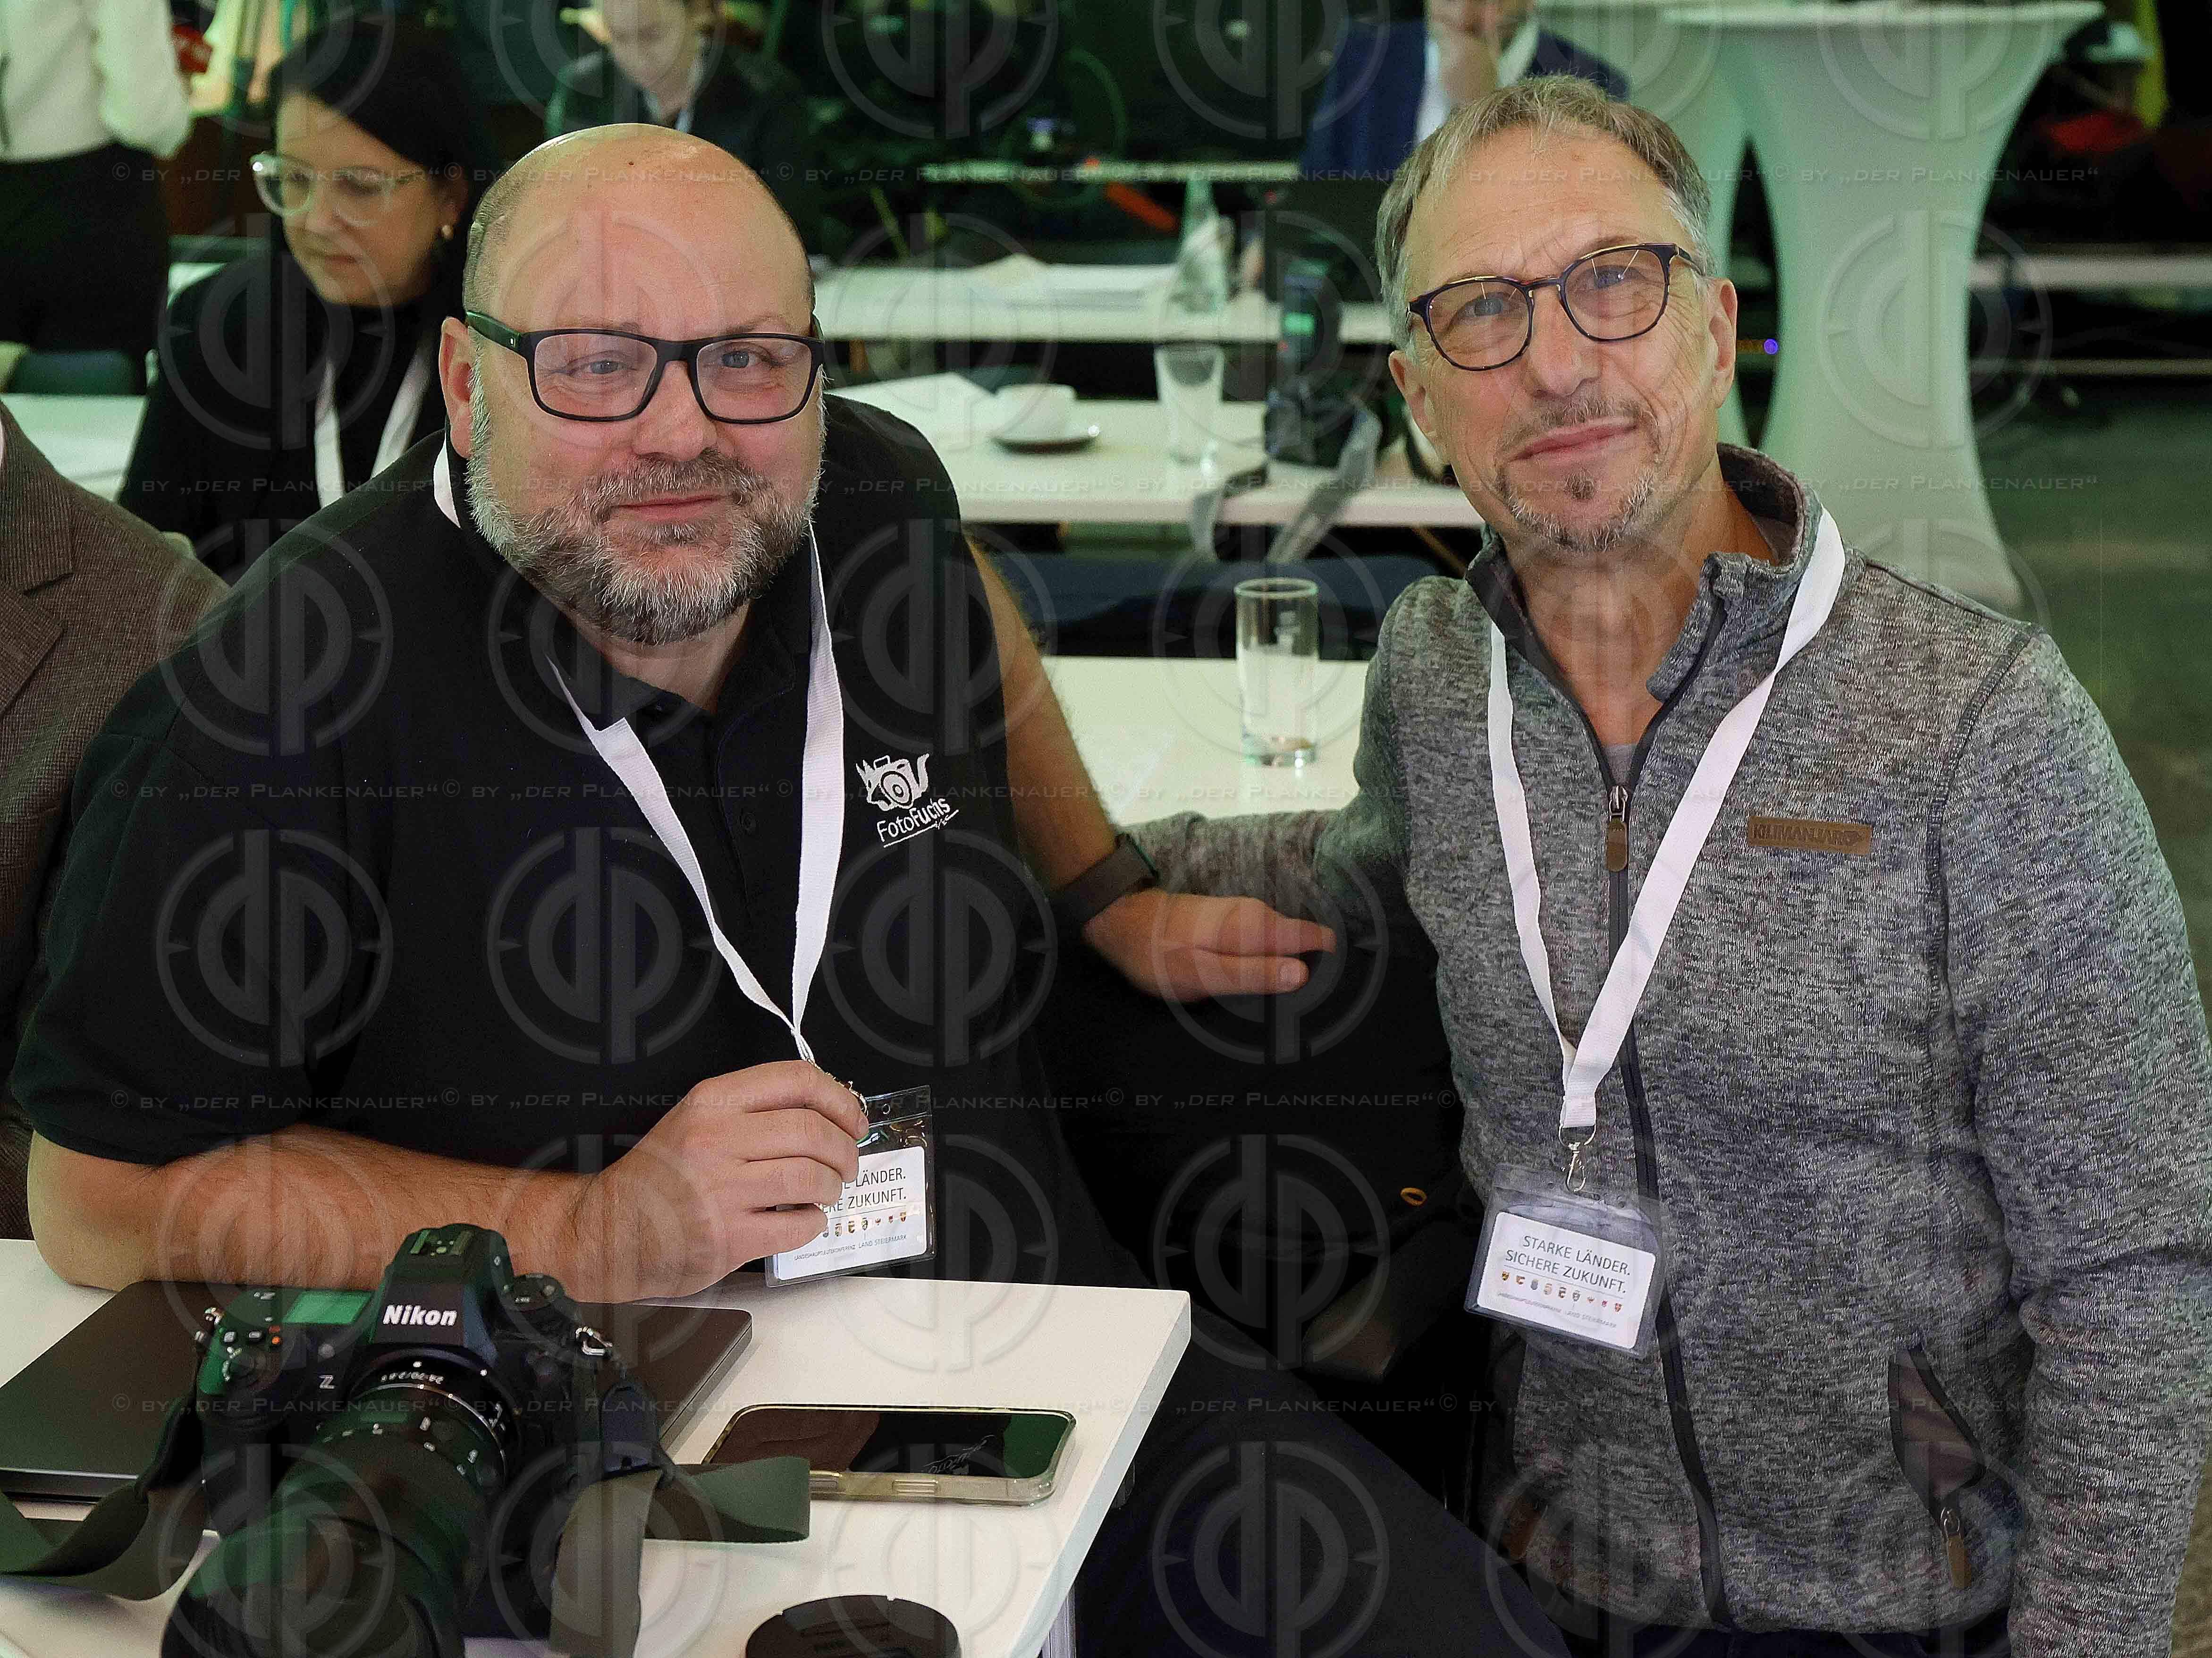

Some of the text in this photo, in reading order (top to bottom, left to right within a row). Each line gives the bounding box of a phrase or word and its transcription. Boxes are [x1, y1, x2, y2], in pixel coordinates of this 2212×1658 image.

[877, 798, 951, 842] FotoFuchs
[855, 1167, 906, 1187] LÄNDER.
[847, 1187, 906, 1209] ZUKUNFT.
[858, 1240, 873, 1249] LAND
[1523, 1235, 1630, 1276] STARKE LÄNDER.
[1505, 1249, 1626, 1294] SICHERE ZUKUNFT.
[382, 1300, 457, 1327] Nikon
[319, 1375, 335, 1389] Z
